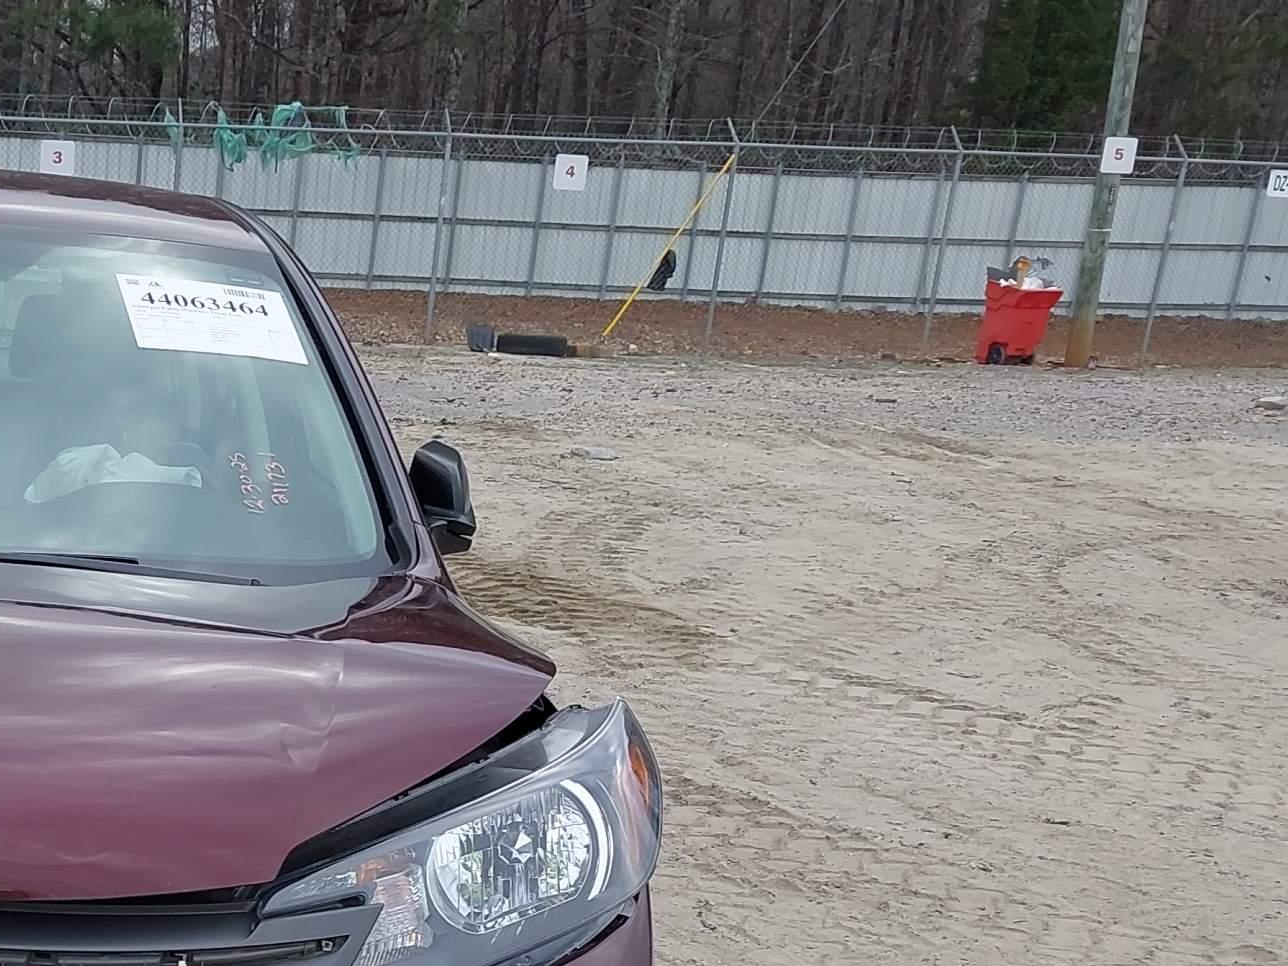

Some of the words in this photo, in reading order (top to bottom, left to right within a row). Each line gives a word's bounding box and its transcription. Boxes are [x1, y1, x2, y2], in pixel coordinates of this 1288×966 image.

[53, 151, 62, 163] 3
[1114, 148, 1124, 160] 5
[565, 166, 575, 177] 4
[141, 291, 269, 317] 44063464
